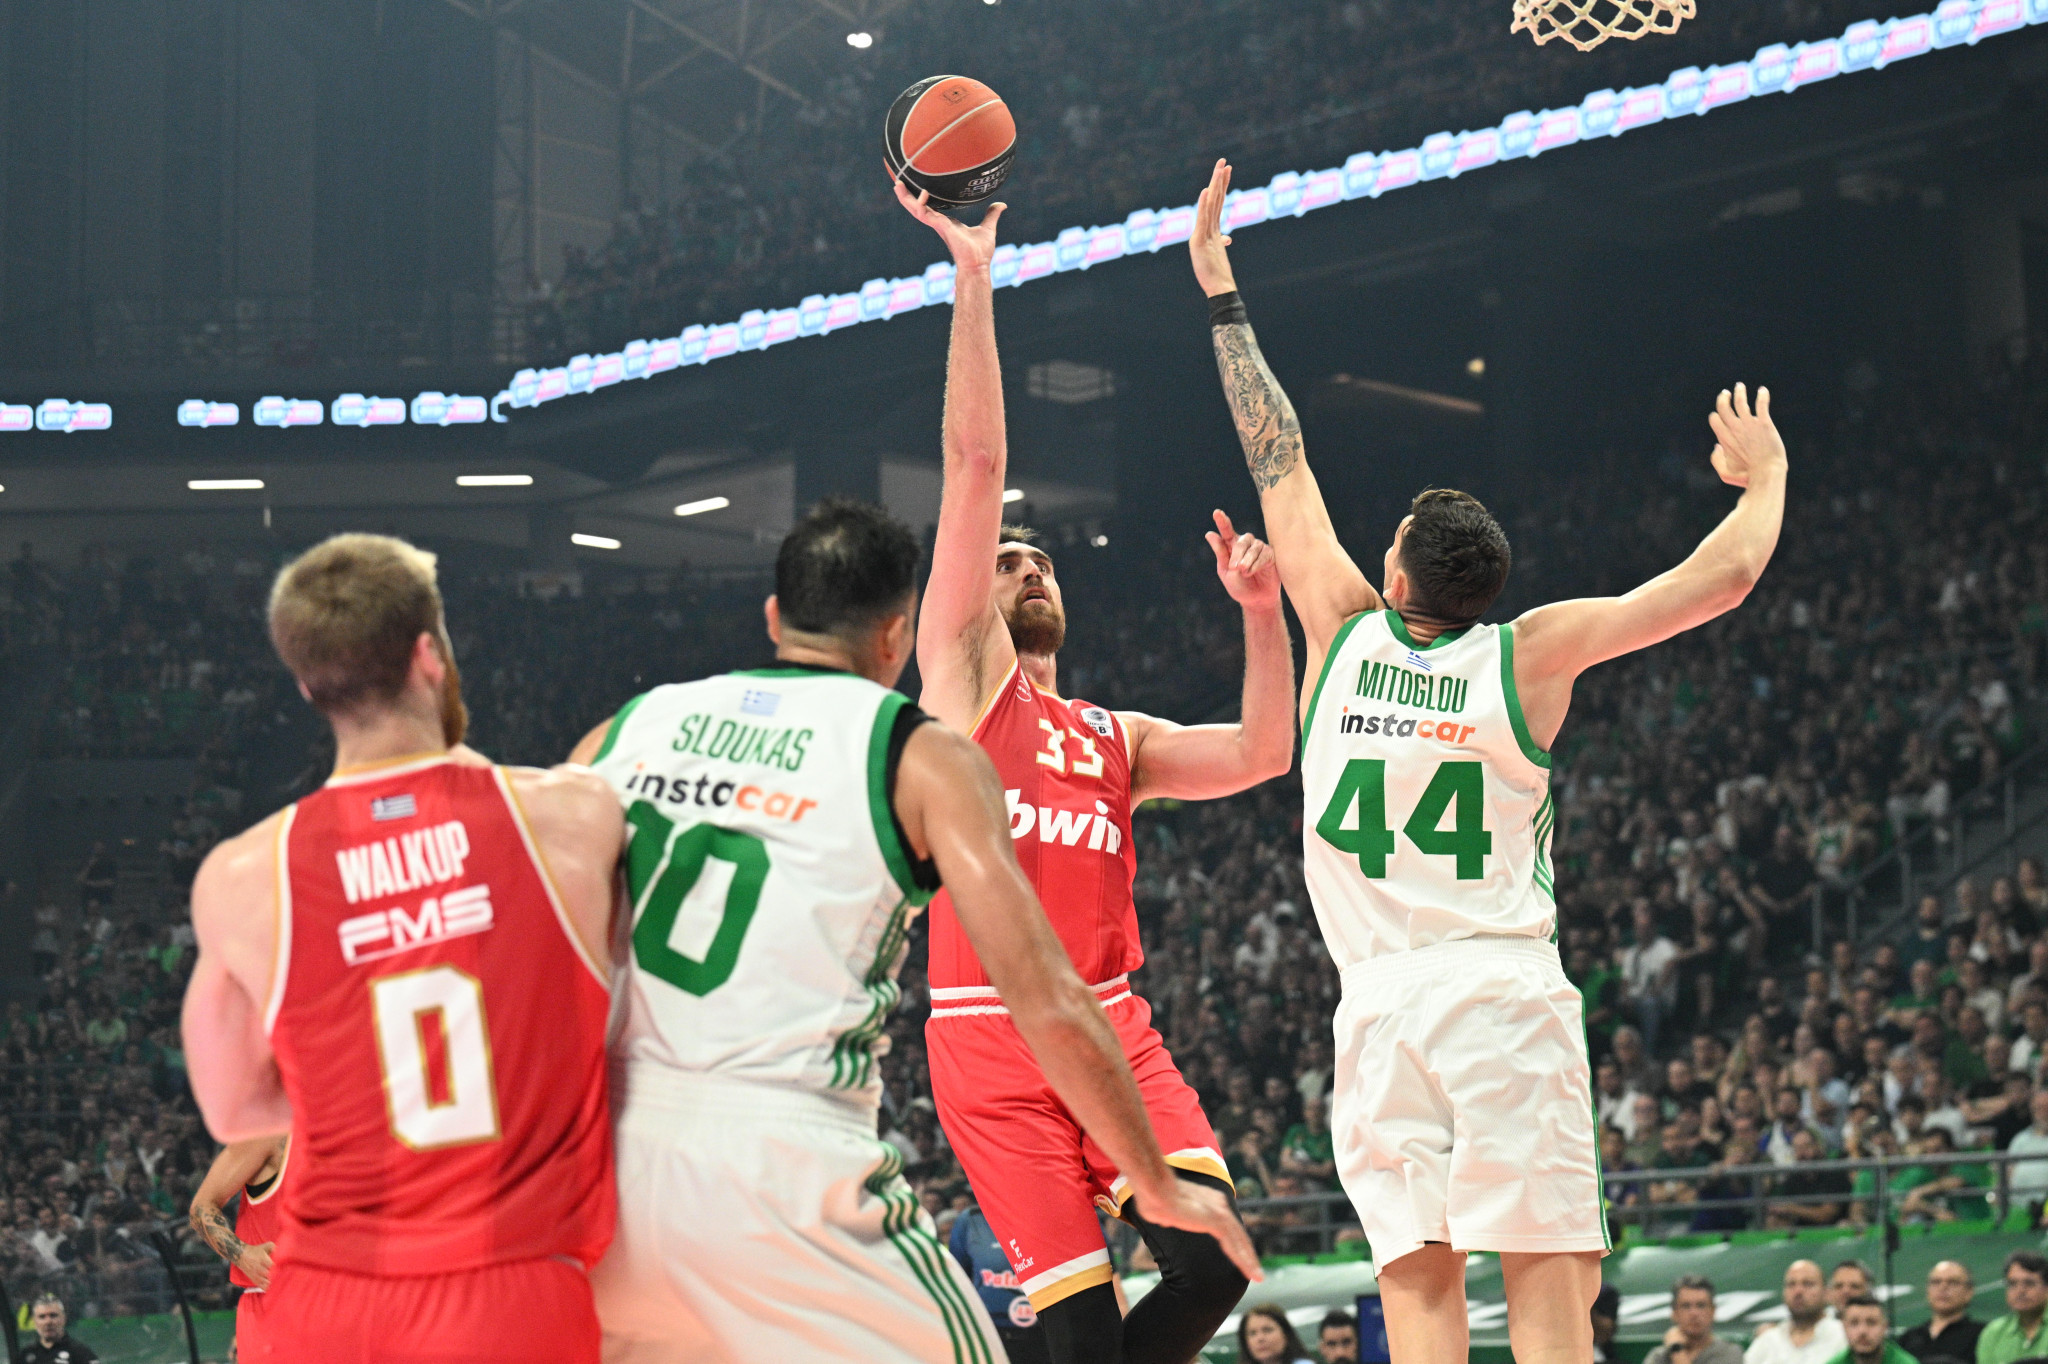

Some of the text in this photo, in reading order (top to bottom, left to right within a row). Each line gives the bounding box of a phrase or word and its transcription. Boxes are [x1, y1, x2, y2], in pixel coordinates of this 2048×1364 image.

[1355, 659, 1468, 713] MITOGLOU
[672, 713, 814, 772] SLOUKAS
[1035, 717, 1104, 779] 33
[1340, 705, 1476, 744] instacar
[626, 762, 817, 822] instacar
[1004, 788, 1124, 858] bwin
[1315, 758, 1492, 880] 44
[336, 820, 470, 904] WALKUP
[338, 884, 493, 965] FMS
[626, 799, 771, 999] 10
[368, 961, 503, 1152] 0
